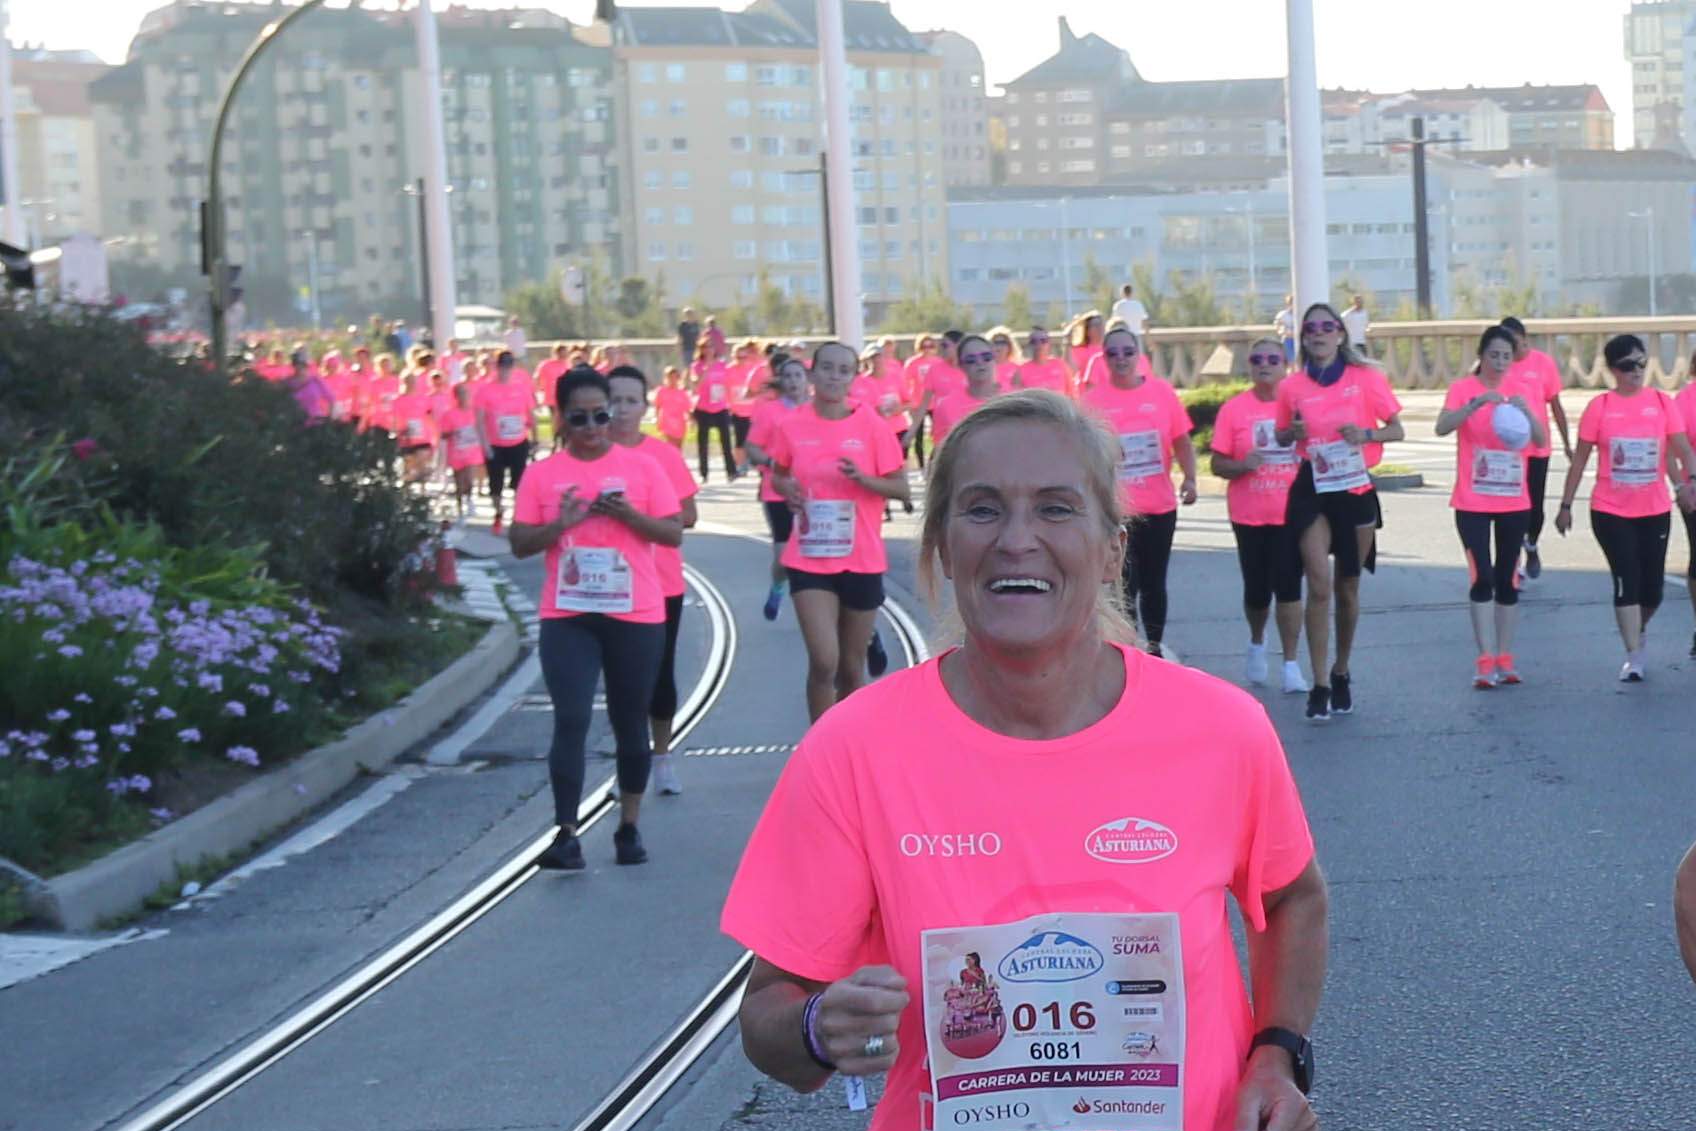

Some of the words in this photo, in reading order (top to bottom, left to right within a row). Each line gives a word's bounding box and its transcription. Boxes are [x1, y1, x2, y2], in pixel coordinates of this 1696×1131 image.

[900, 832, 1001, 857] OYSHO
[1093, 835, 1171, 852] ASTURIANA
[1113, 943, 1160, 955] SUMA
[1007, 956, 1095, 976] ASTURIANA
[1012, 1001, 1097, 1031] 016
[1030, 1042, 1080, 1059] 6081
[958, 1070, 1027, 1091] CARRERA
[1030, 1071, 1050, 1083] DE
[1054, 1070, 1072, 1082] LA
[1076, 1069, 1124, 1081] MUJER
[1130, 1069, 1161, 1081] 2023
[954, 1102, 1030, 1125] OYSHO
[1093, 1099, 1166, 1114] Santander
